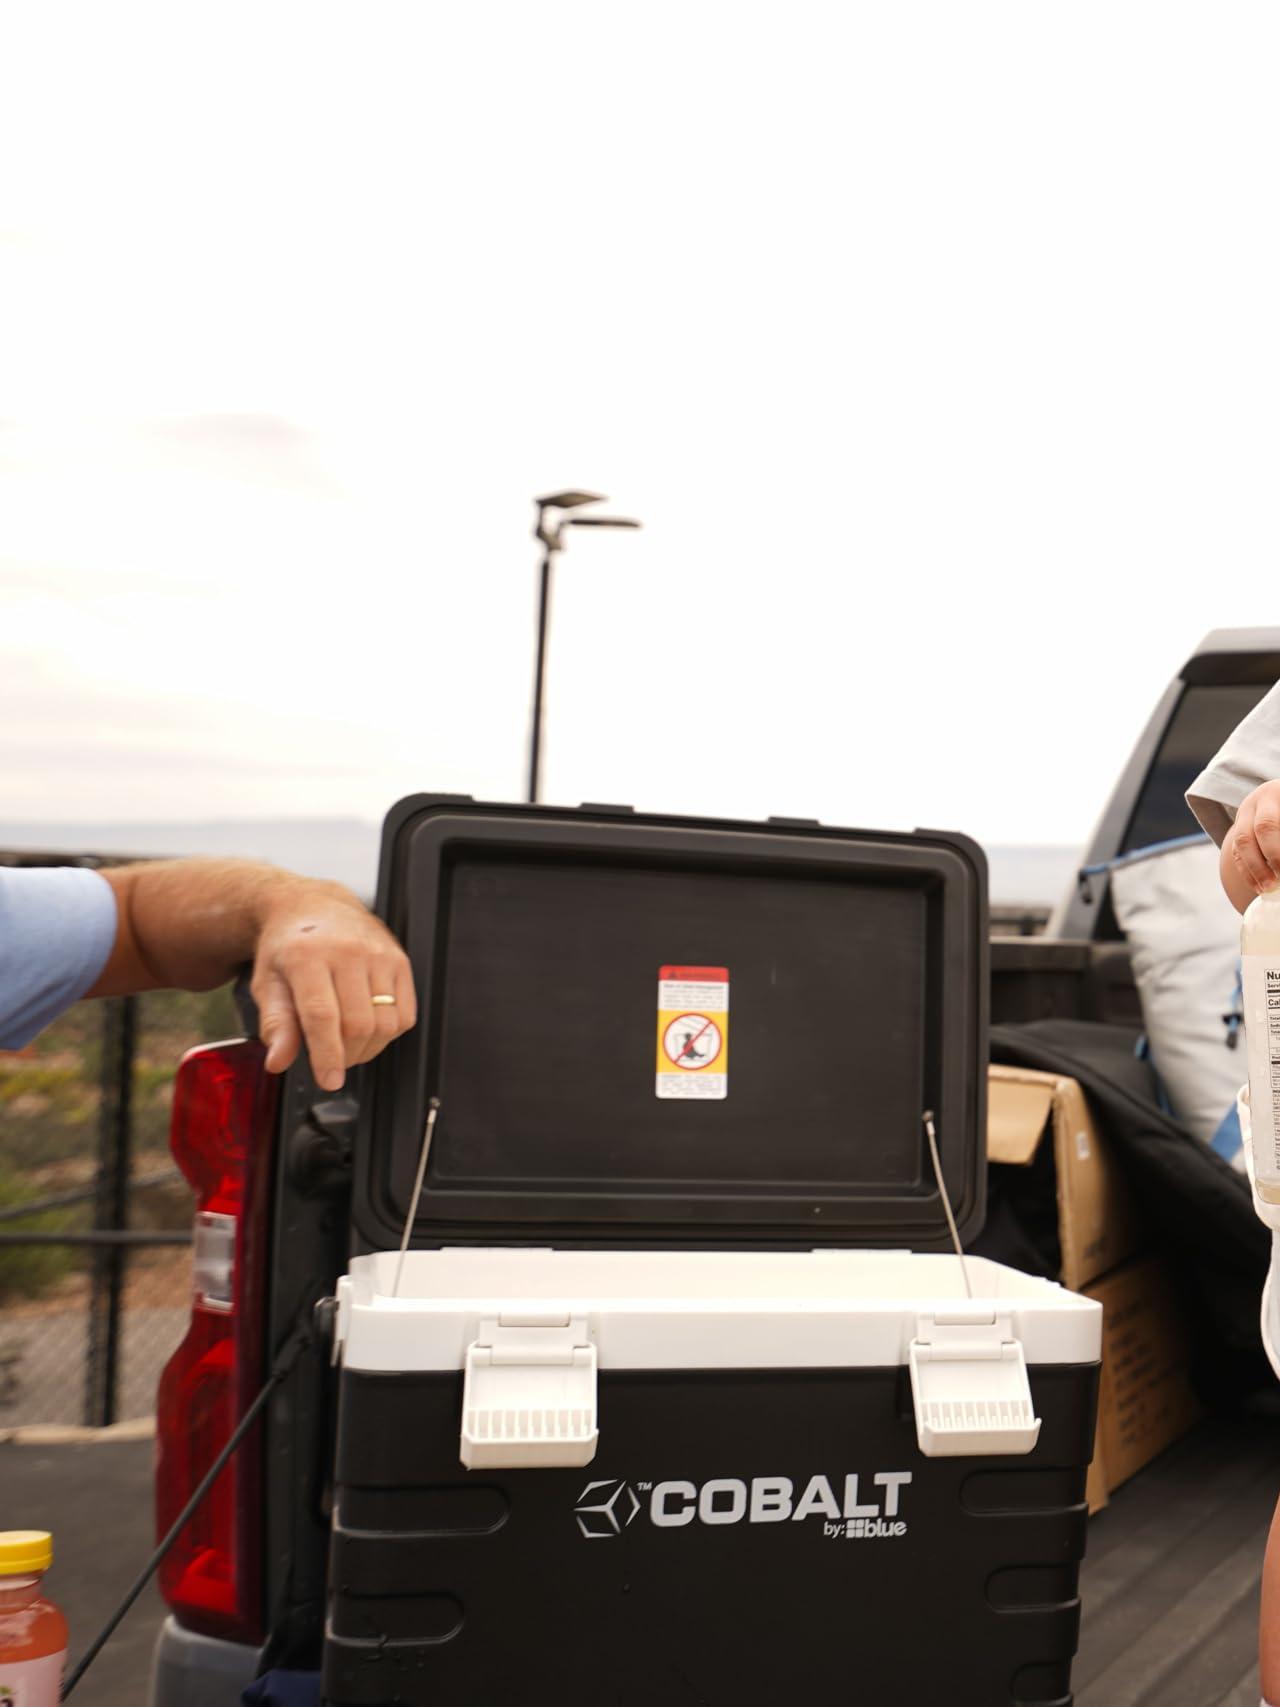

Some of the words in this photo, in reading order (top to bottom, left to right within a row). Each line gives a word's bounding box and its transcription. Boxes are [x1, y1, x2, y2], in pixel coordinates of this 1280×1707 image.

[650, 1471, 913, 1528] COBALT
[824, 1520, 846, 1538] by:
[864, 1518, 908, 1538] blue
